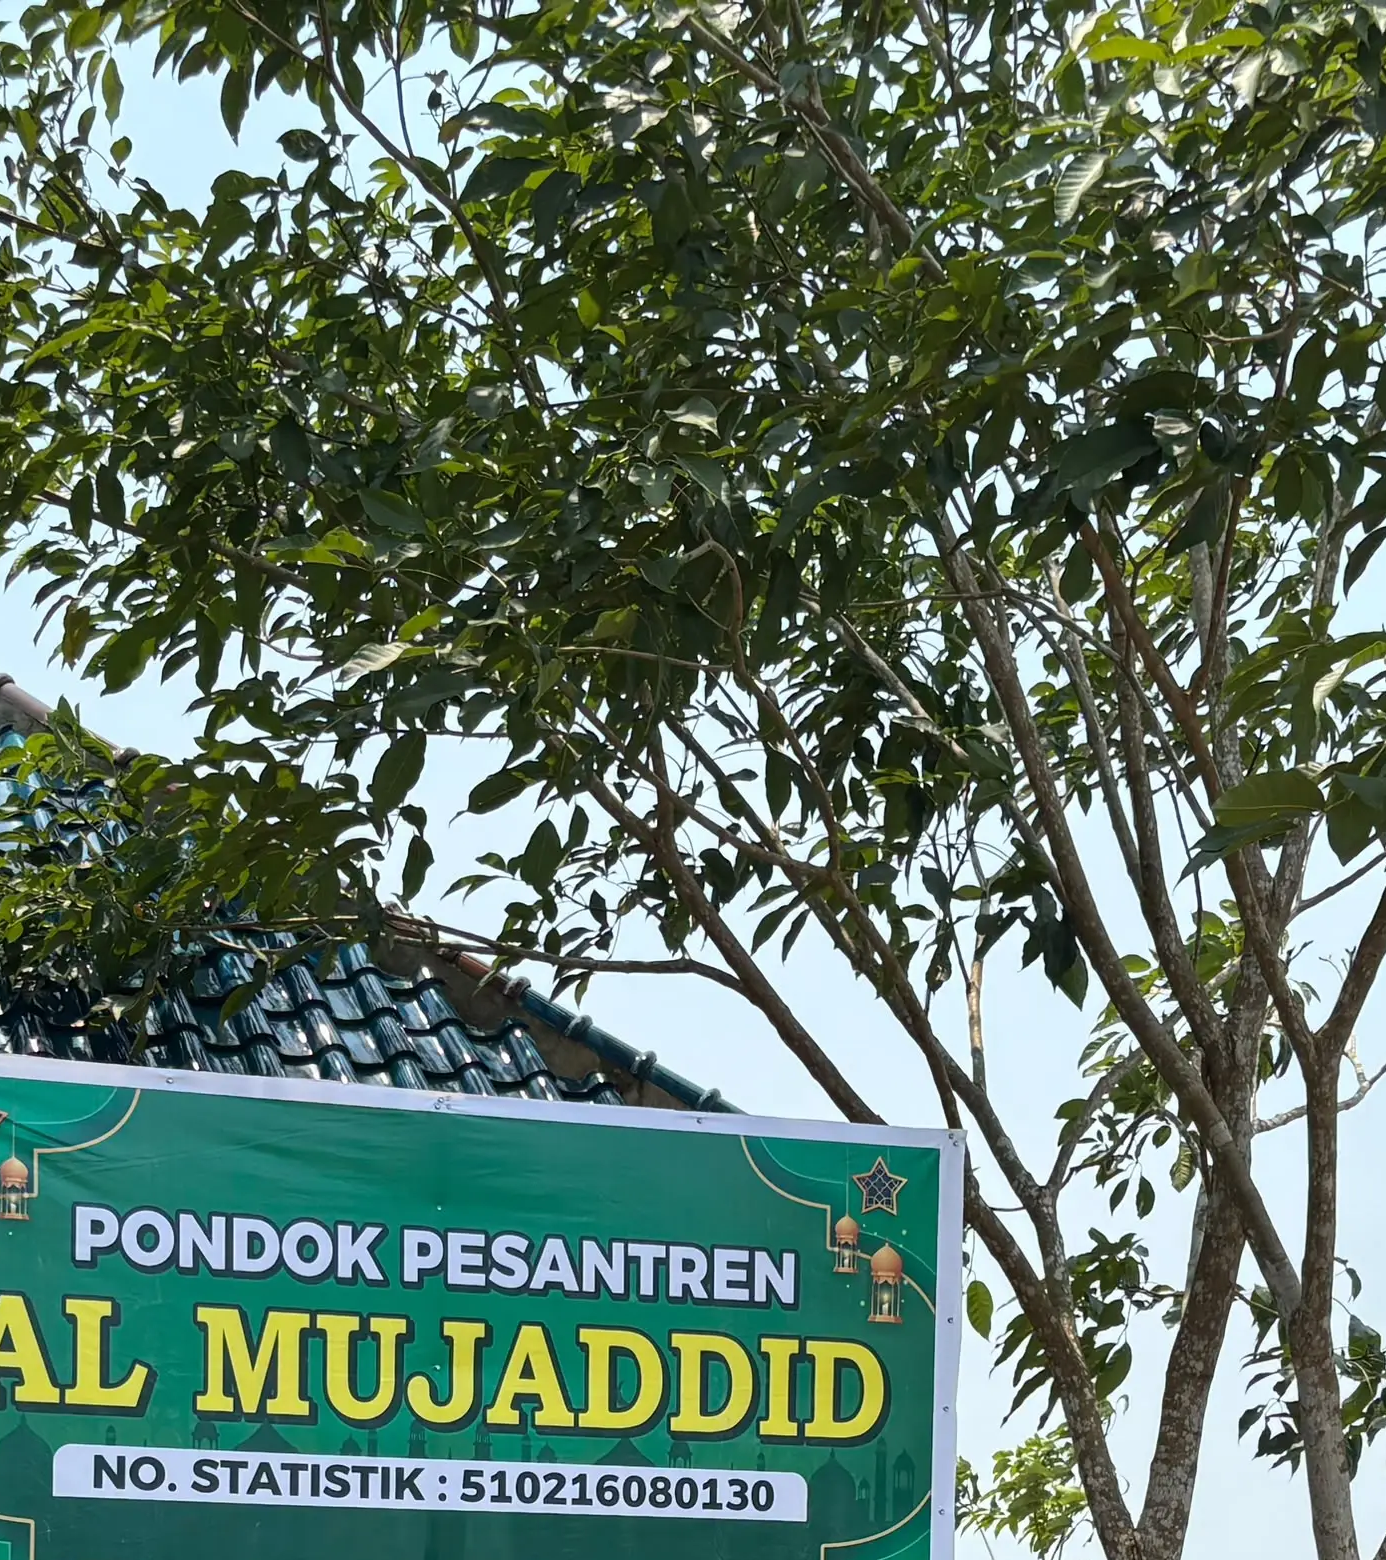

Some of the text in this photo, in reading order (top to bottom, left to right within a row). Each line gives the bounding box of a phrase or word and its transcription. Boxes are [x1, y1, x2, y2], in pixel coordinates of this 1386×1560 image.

[73, 1205, 797, 1305] PONDOK PESANTREN
[194, 1305, 886, 1440] MUJADDID
[93, 1454, 775, 1512] NO. STATISTIK : 510216080130
